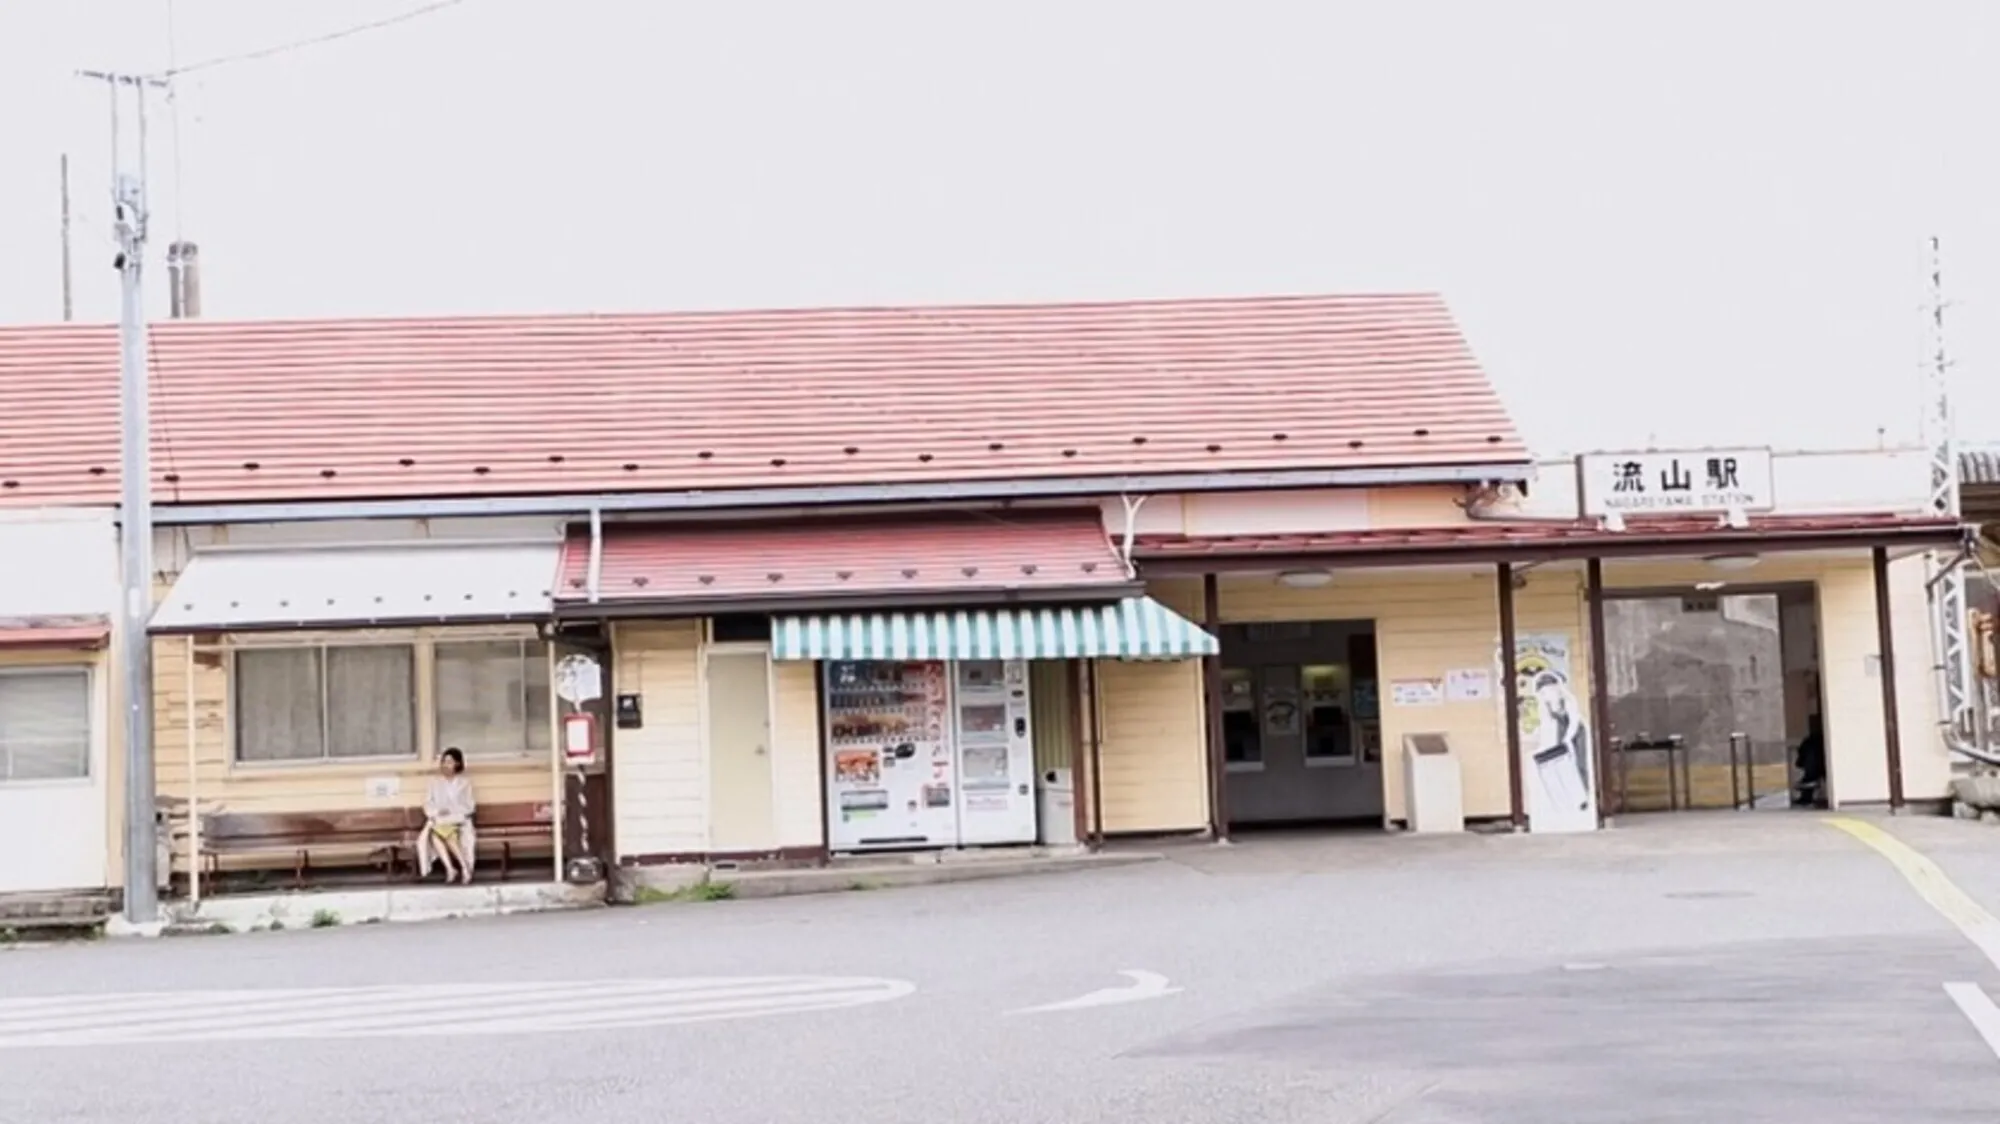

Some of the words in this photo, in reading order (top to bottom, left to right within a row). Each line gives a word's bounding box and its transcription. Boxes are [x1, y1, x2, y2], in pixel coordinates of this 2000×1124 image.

[1612, 458, 1739, 493] 流山駅
[1604, 496, 1693, 508] NAGAREYAMA
[1701, 493, 1754, 504] STATION
